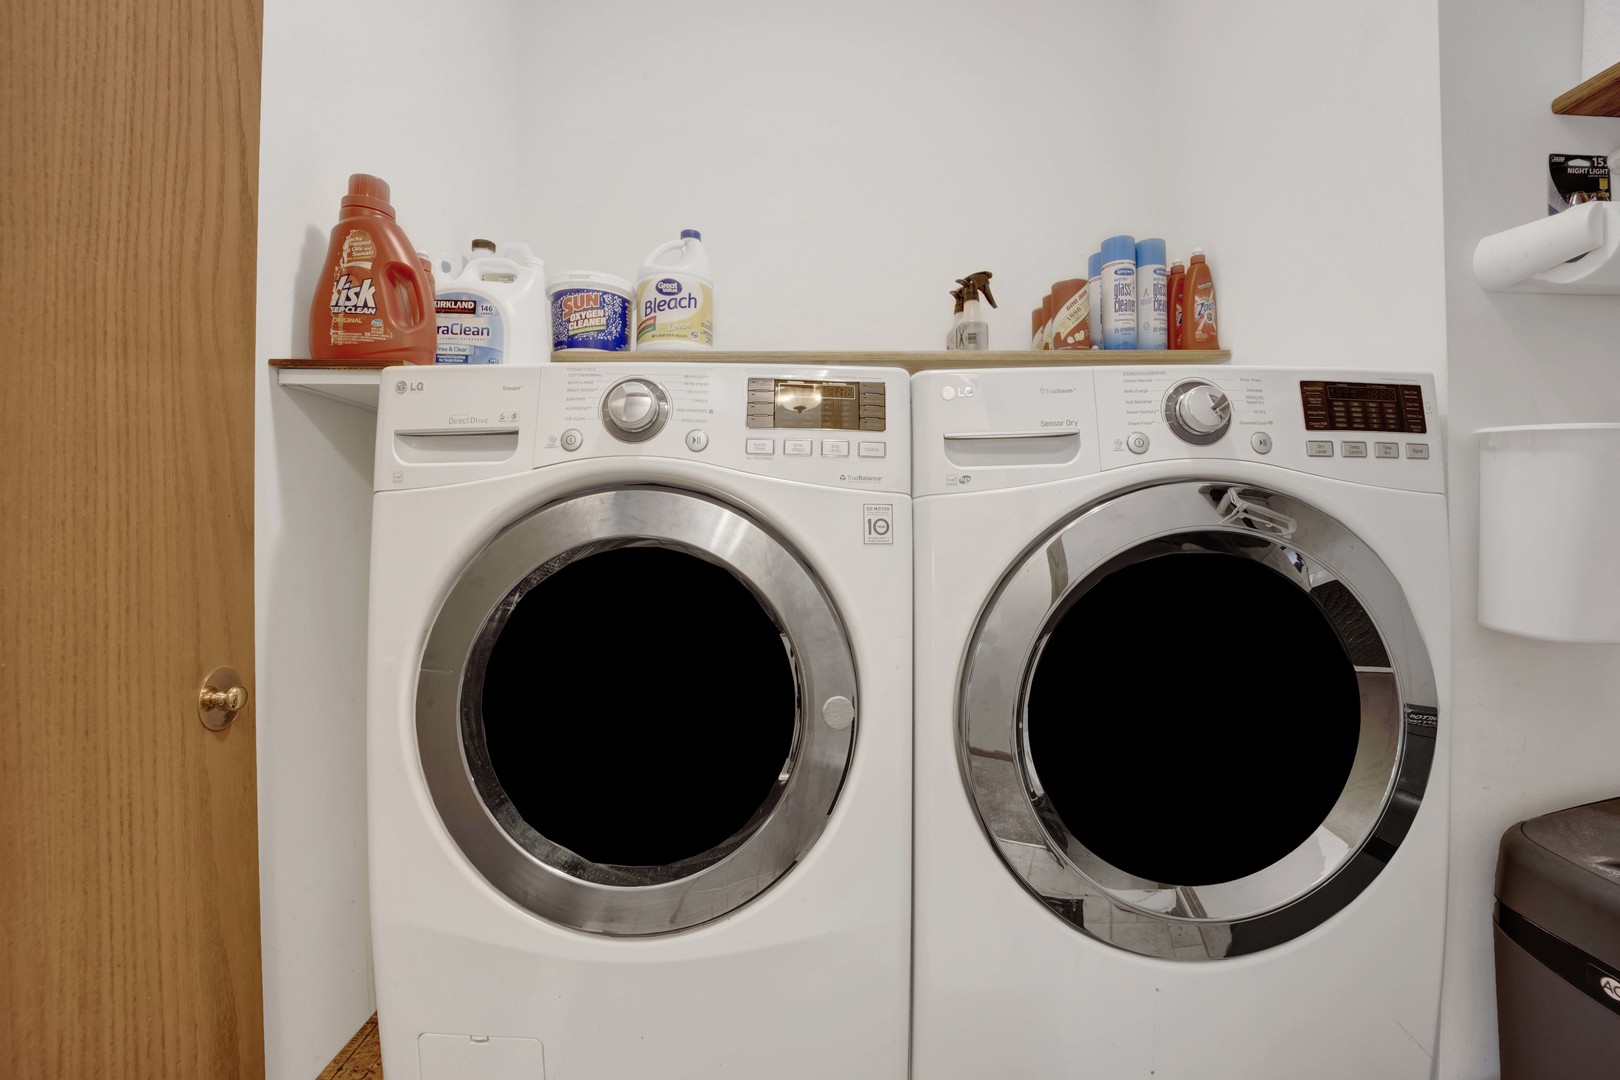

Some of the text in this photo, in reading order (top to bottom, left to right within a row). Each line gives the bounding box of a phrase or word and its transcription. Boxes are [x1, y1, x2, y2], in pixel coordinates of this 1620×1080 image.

[1114, 282, 1131, 300] glass
[345, 307, 377, 315] CLEAN
[435, 300, 475, 309] KIRKLAND
[562, 292, 600, 321] SUN
[644, 292, 698, 318] Bleach
[570, 309, 604, 322] OXYGEN
[436, 323, 490, 336] raClean
[568, 317, 607, 330] CLEANER
[410, 382, 425, 391] LG
[957, 387, 973, 397] LG
[1066, 419, 1078, 428] Dry
[868, 518, 890, 536] 10
